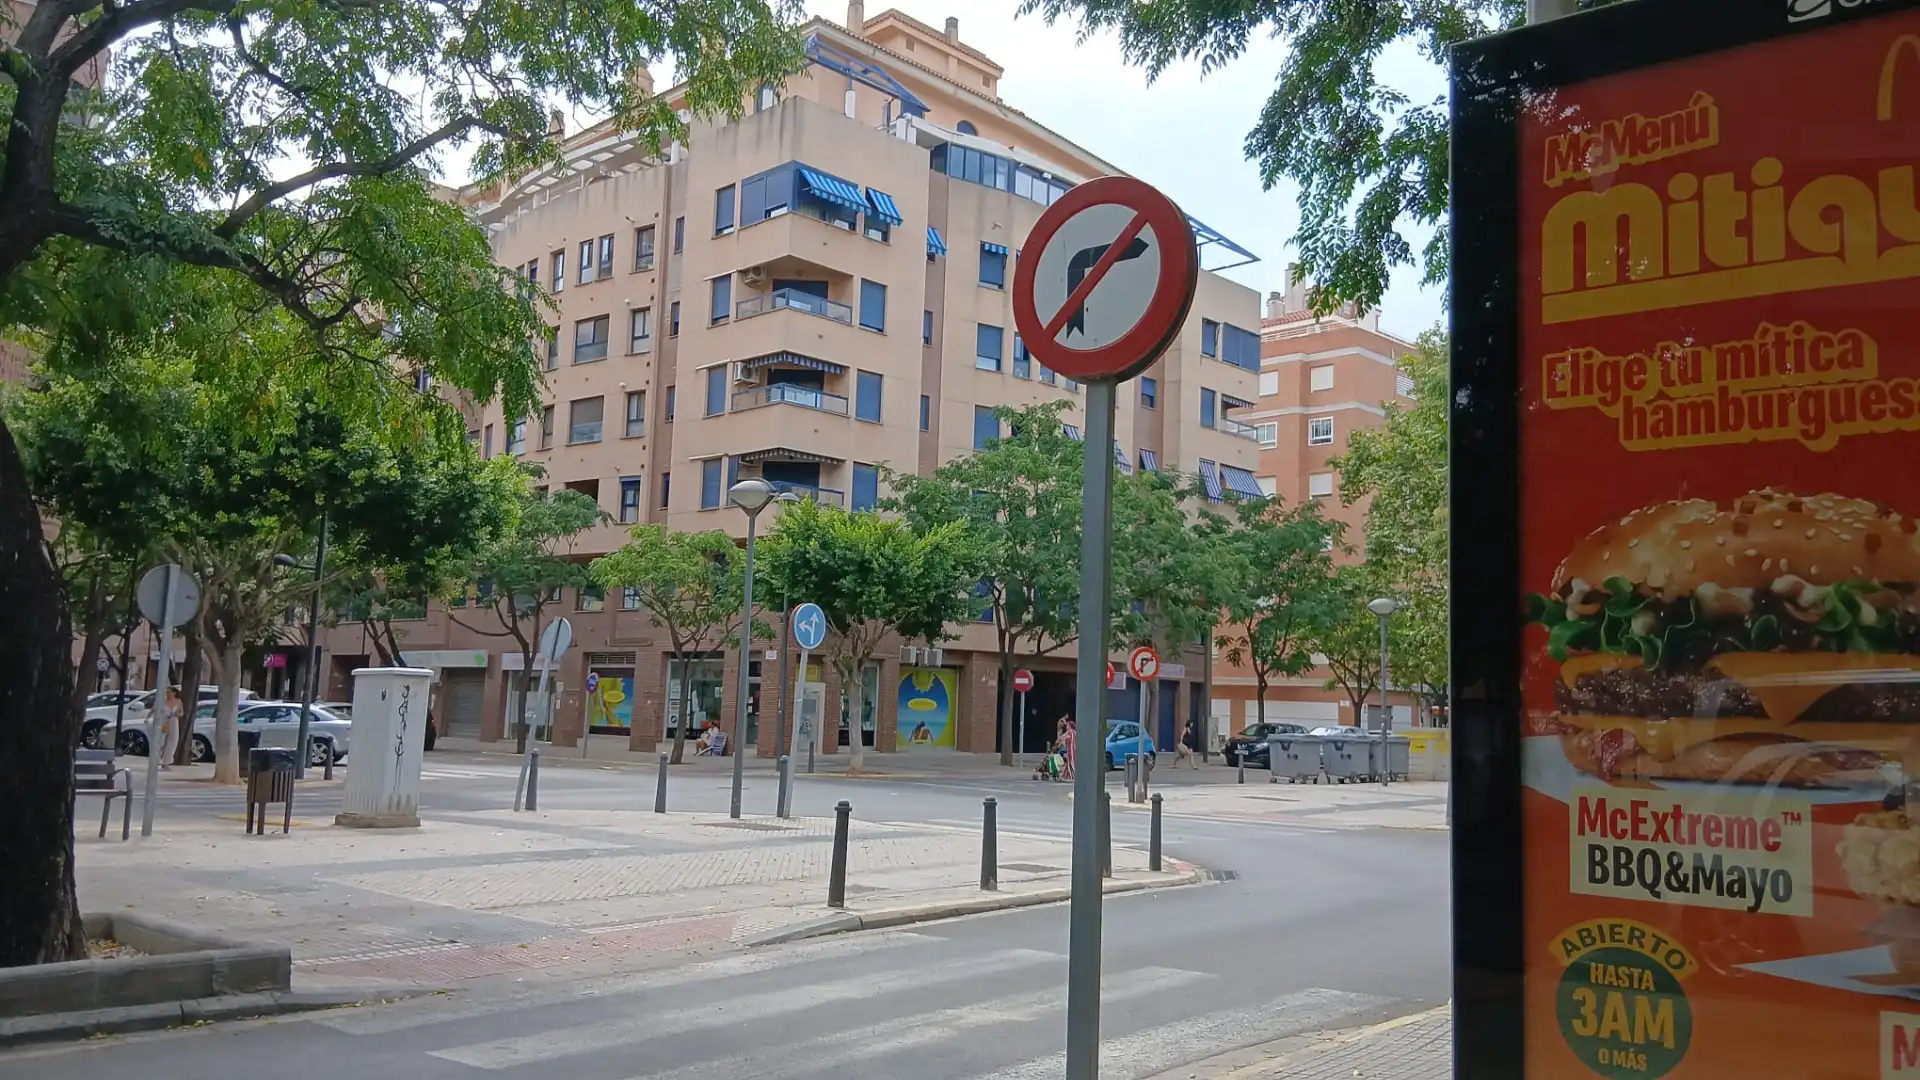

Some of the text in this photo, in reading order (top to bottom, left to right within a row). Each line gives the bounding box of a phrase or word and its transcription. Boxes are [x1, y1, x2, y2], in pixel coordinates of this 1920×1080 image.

[1545, 92, 1714, 183] McMenú
[1546, 325, 1865, 406] Elige tu mítica
[1623, 381, 1920, 441] hamburgues
[1588, 843, 1793, 913] BBQ&Mayo
[1590, 962, 1656, 992] HASTA
[1572, 987, 1675, 1050] 3AM
[1598, 1047, 1647, 1072] O MÁS
